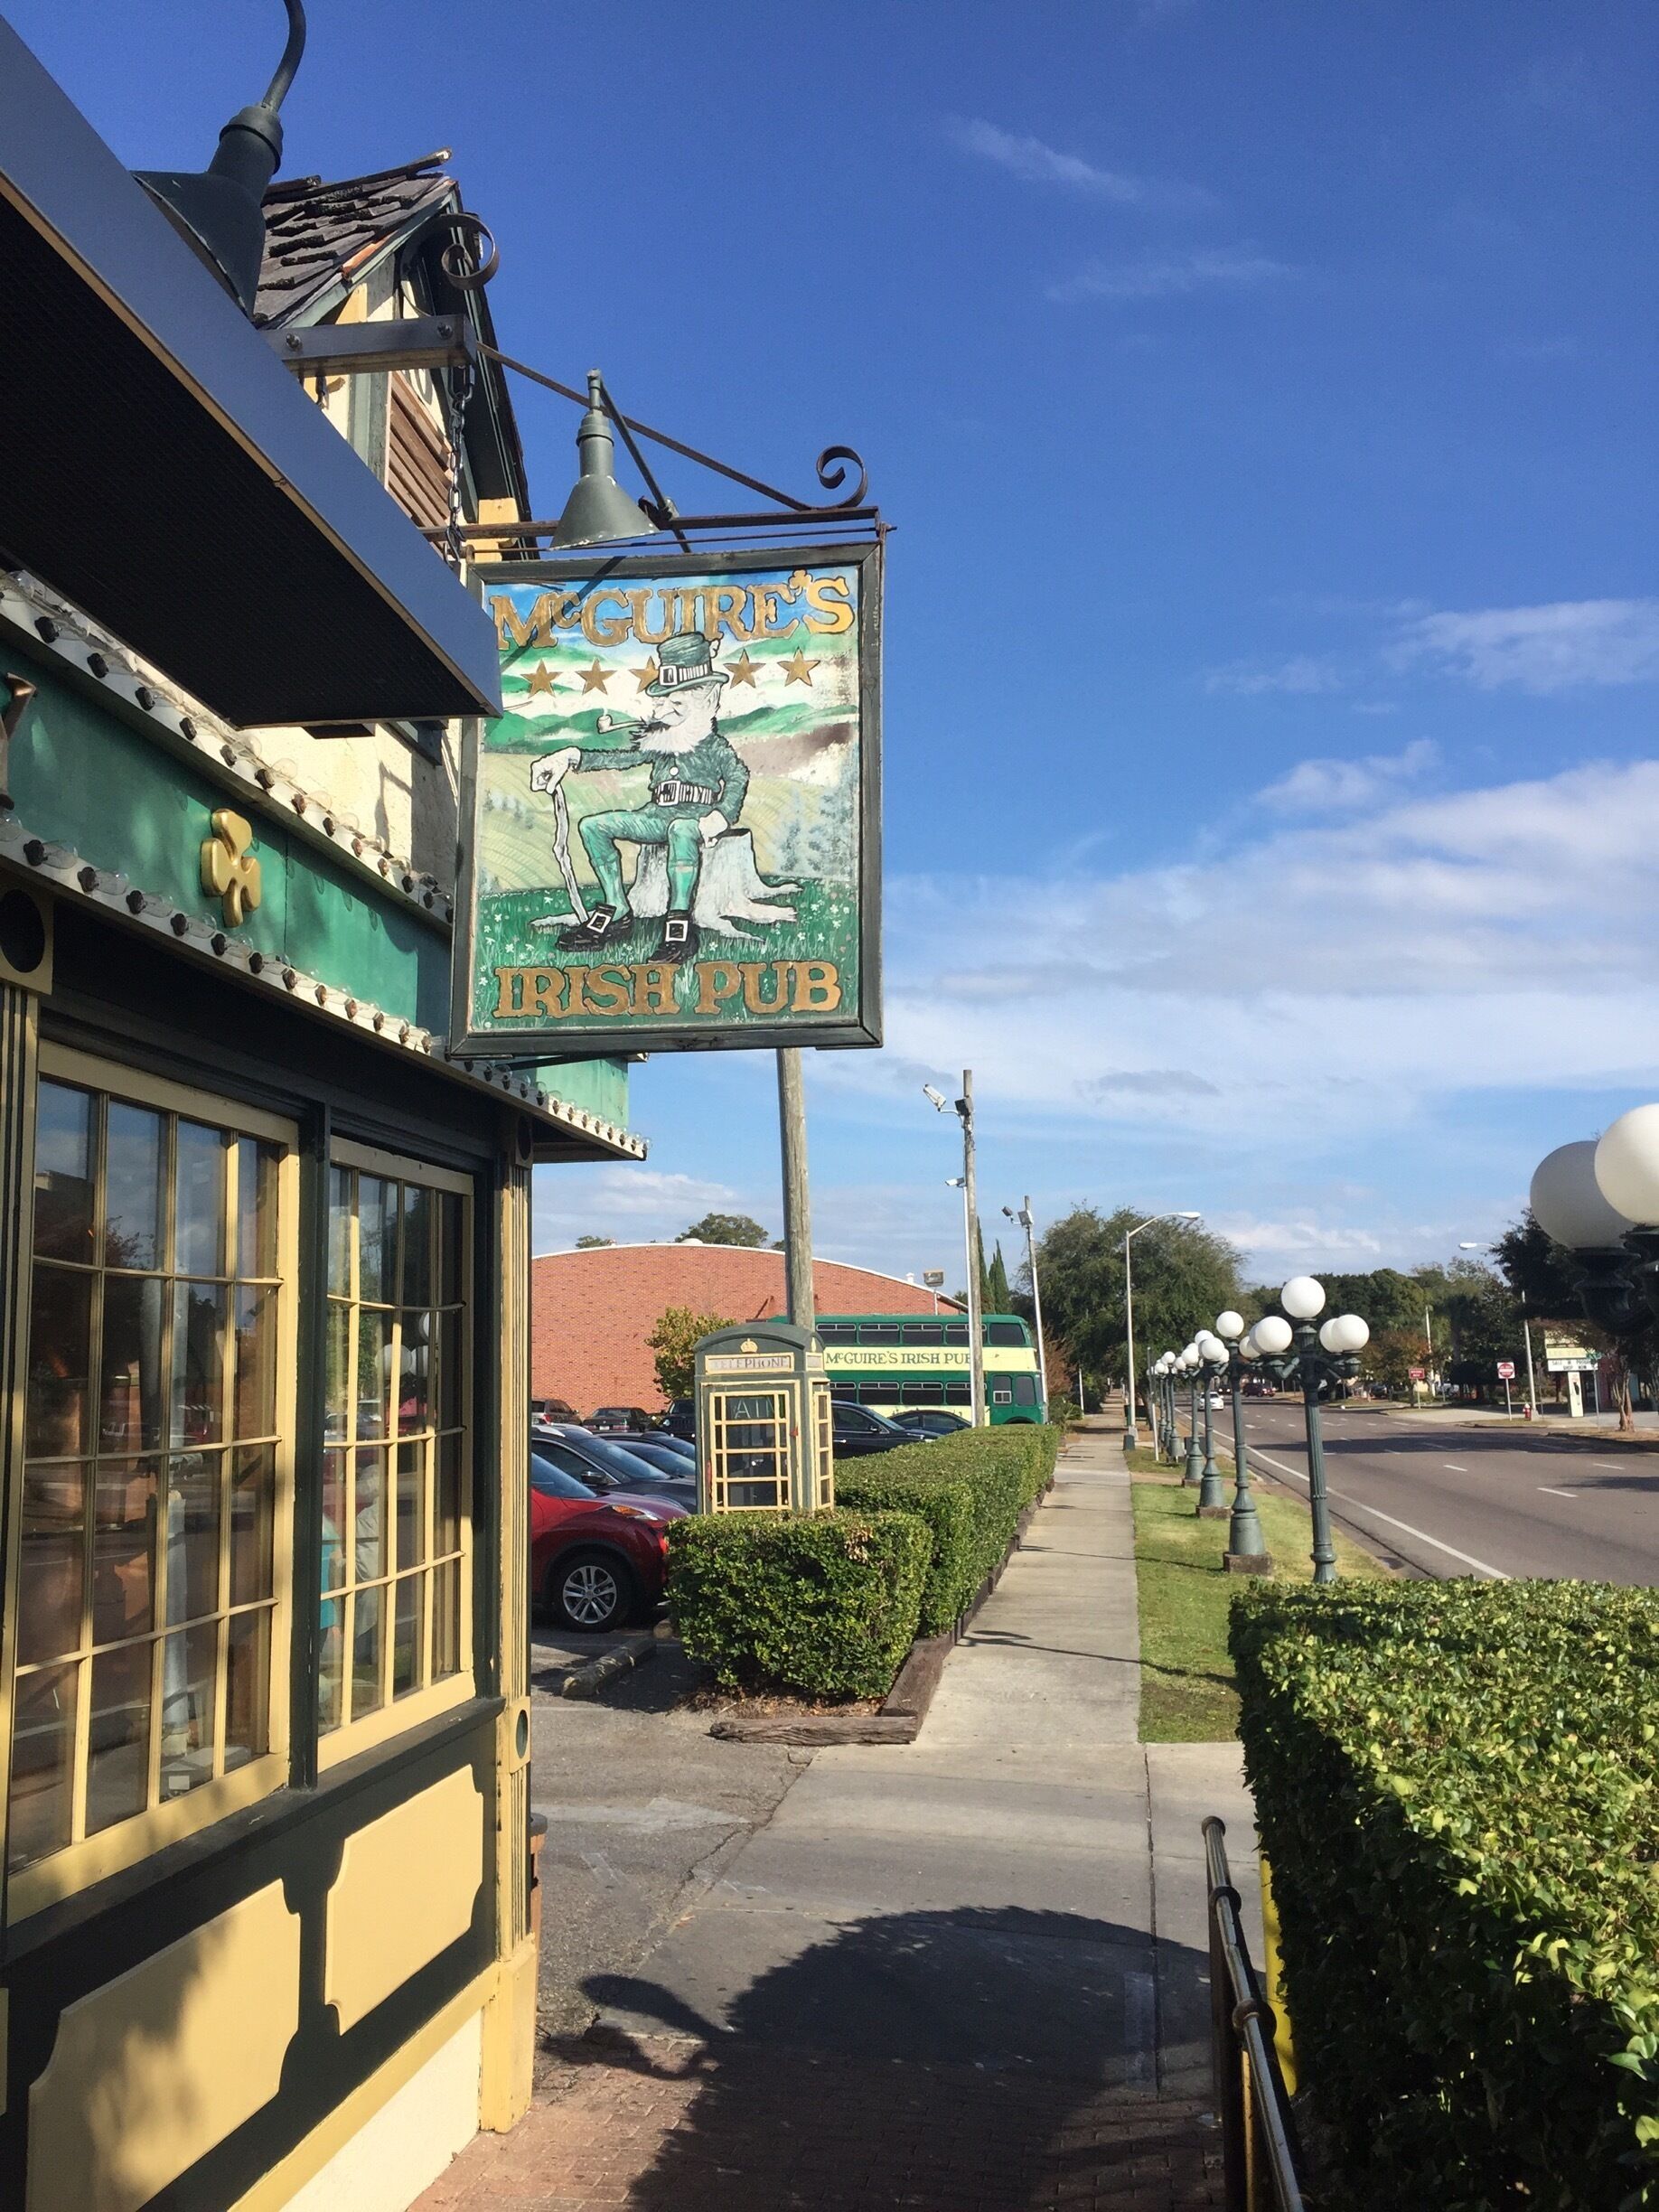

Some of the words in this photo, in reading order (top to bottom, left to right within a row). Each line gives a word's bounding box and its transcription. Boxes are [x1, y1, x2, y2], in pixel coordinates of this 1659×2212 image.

[489, 570, 856, 651] McGUIRE'S
[492, 961, 681, 1018] IRISH
[693, 961, 842, 1014] PUB
[826, 1351, 898, 1364] McGUIRE'S
[901, 1353, 941, 1364] IRISH
